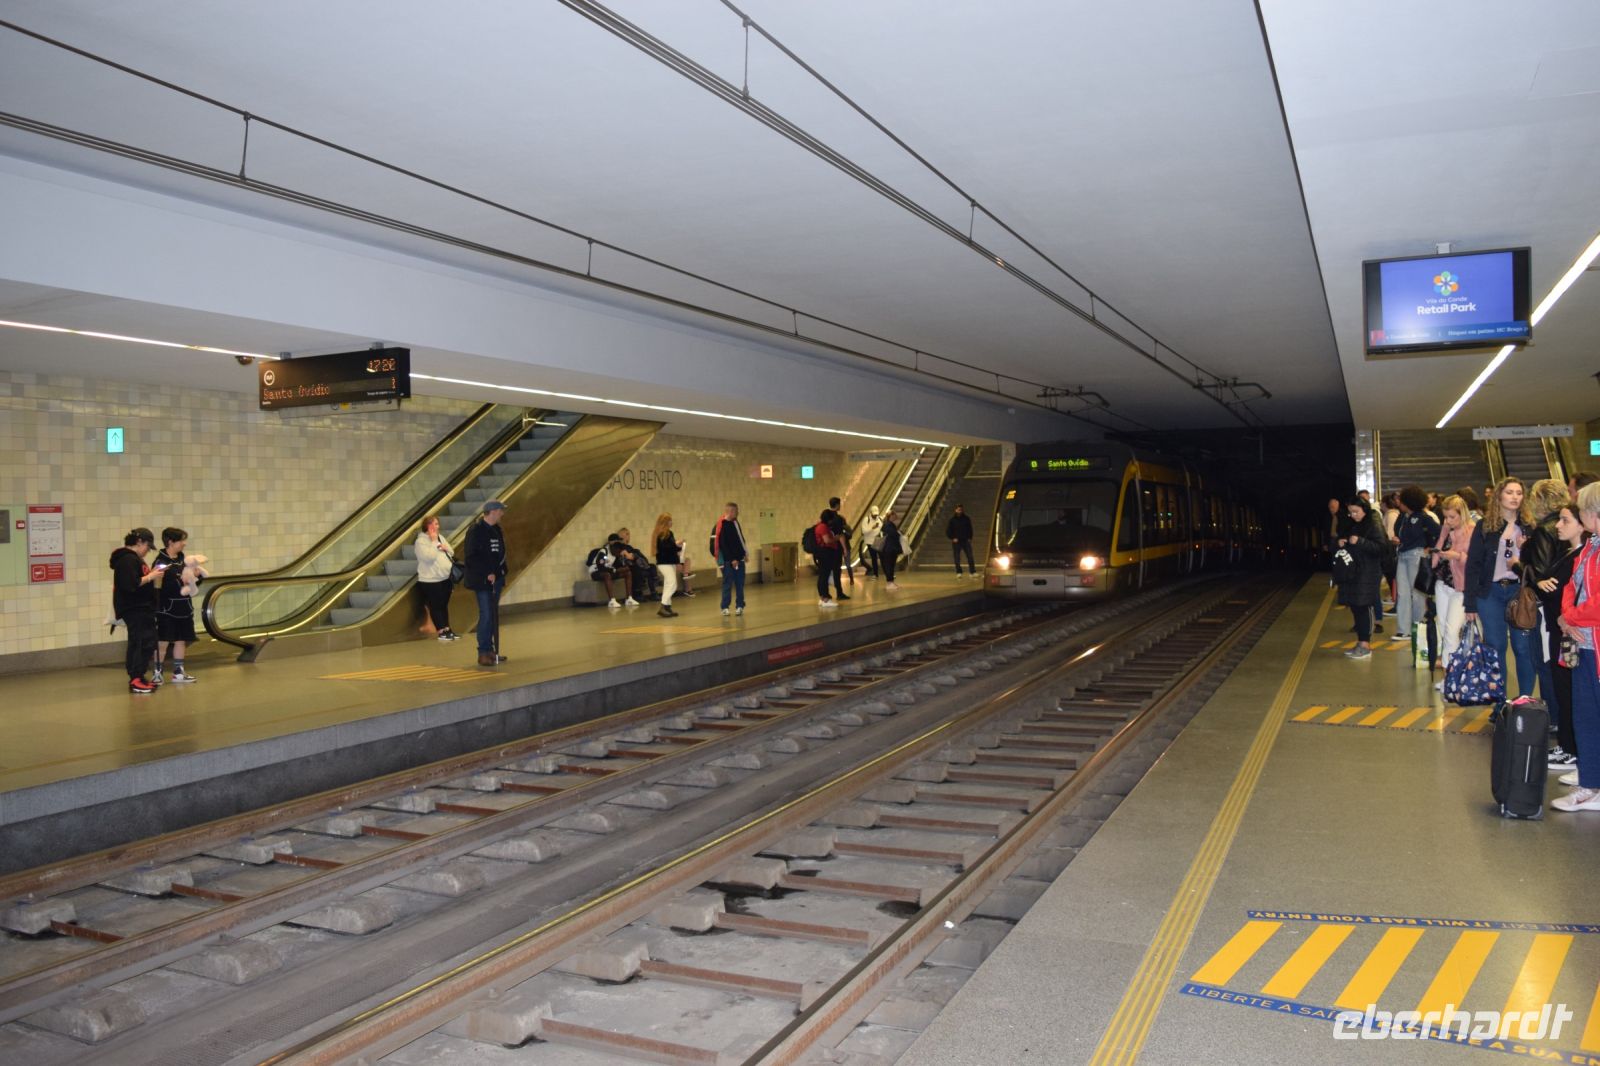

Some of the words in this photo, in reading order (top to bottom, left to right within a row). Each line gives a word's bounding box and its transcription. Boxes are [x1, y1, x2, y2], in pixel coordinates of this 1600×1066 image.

[1417, 304, 1449, 315] Retail
[1450, 302, 1477, 313] Park
[263, 388, 293, 401] Santo
[1047, 459, 1067, 468] Santo
[640, 469, 683, 490] BENTO
[1316, 914, 1365, 923] YOUR
[1370, 916, 1417, 925] EASE
[1421, 919, 1469, 927] WILL
[1473, 920, 1491, 928] IT
[1187, 986, 1273, 1008] LIBERTE
[1278, 1003, 1293, 1012] A
[1488, 1041, 1506, 1050] A
[1512, 1044, 1564, 1061] SUA
